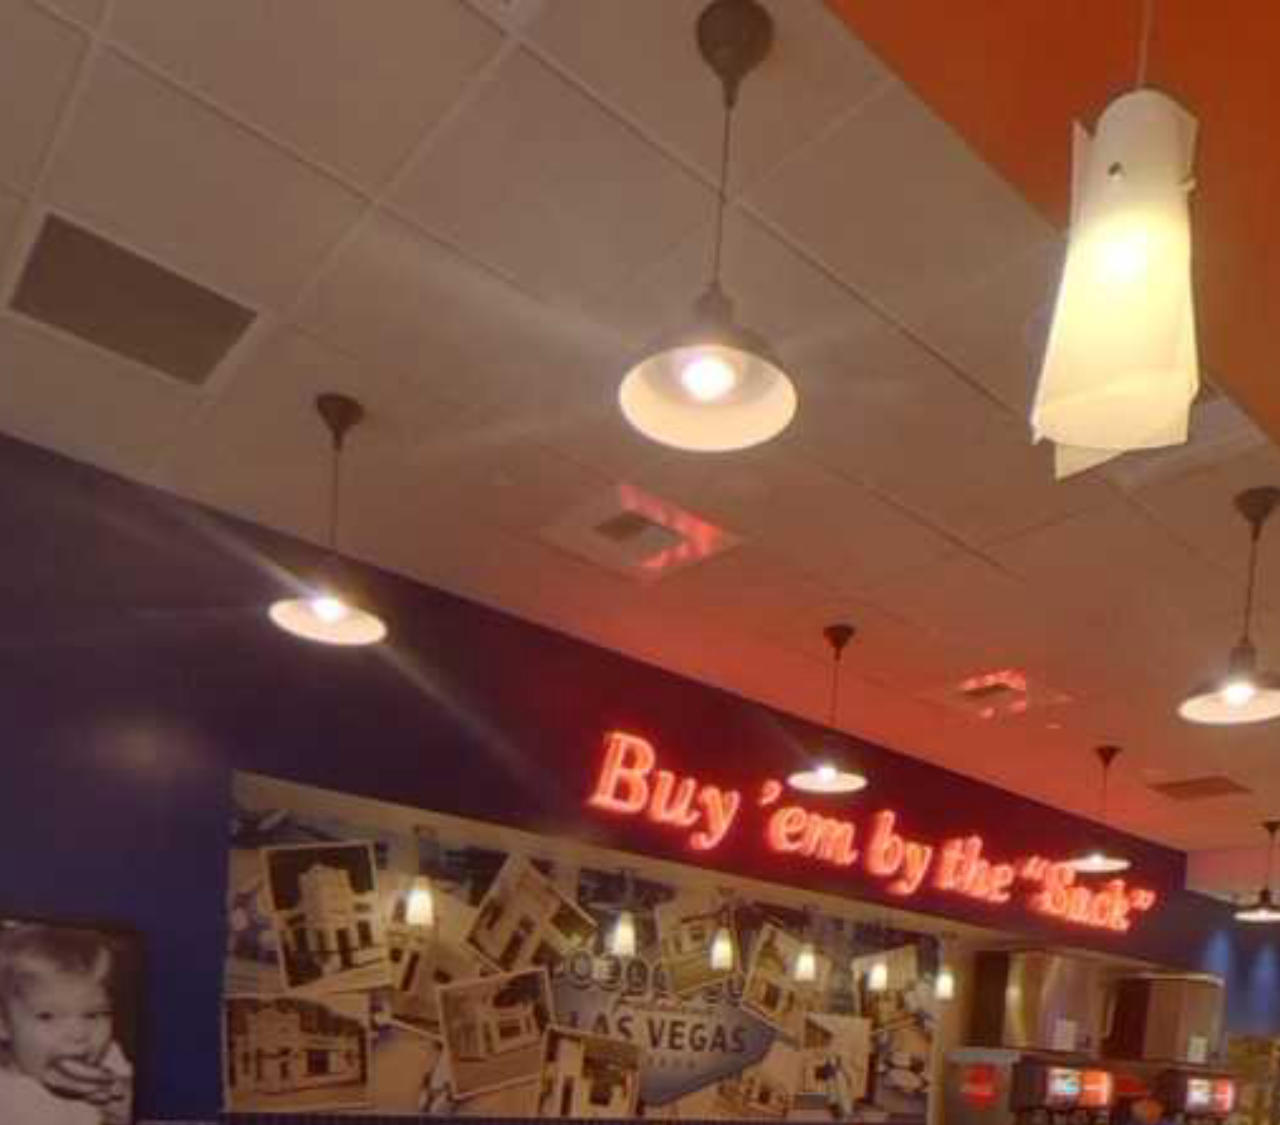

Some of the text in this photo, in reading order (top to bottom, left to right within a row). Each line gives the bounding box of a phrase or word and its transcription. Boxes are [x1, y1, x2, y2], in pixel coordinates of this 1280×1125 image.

[588, 729, 741, 850] Buy
[867, 809, 933, 895] by
[936, 834, 1014, 903] the
[646, 1016, 746, 1052] VEGAS
